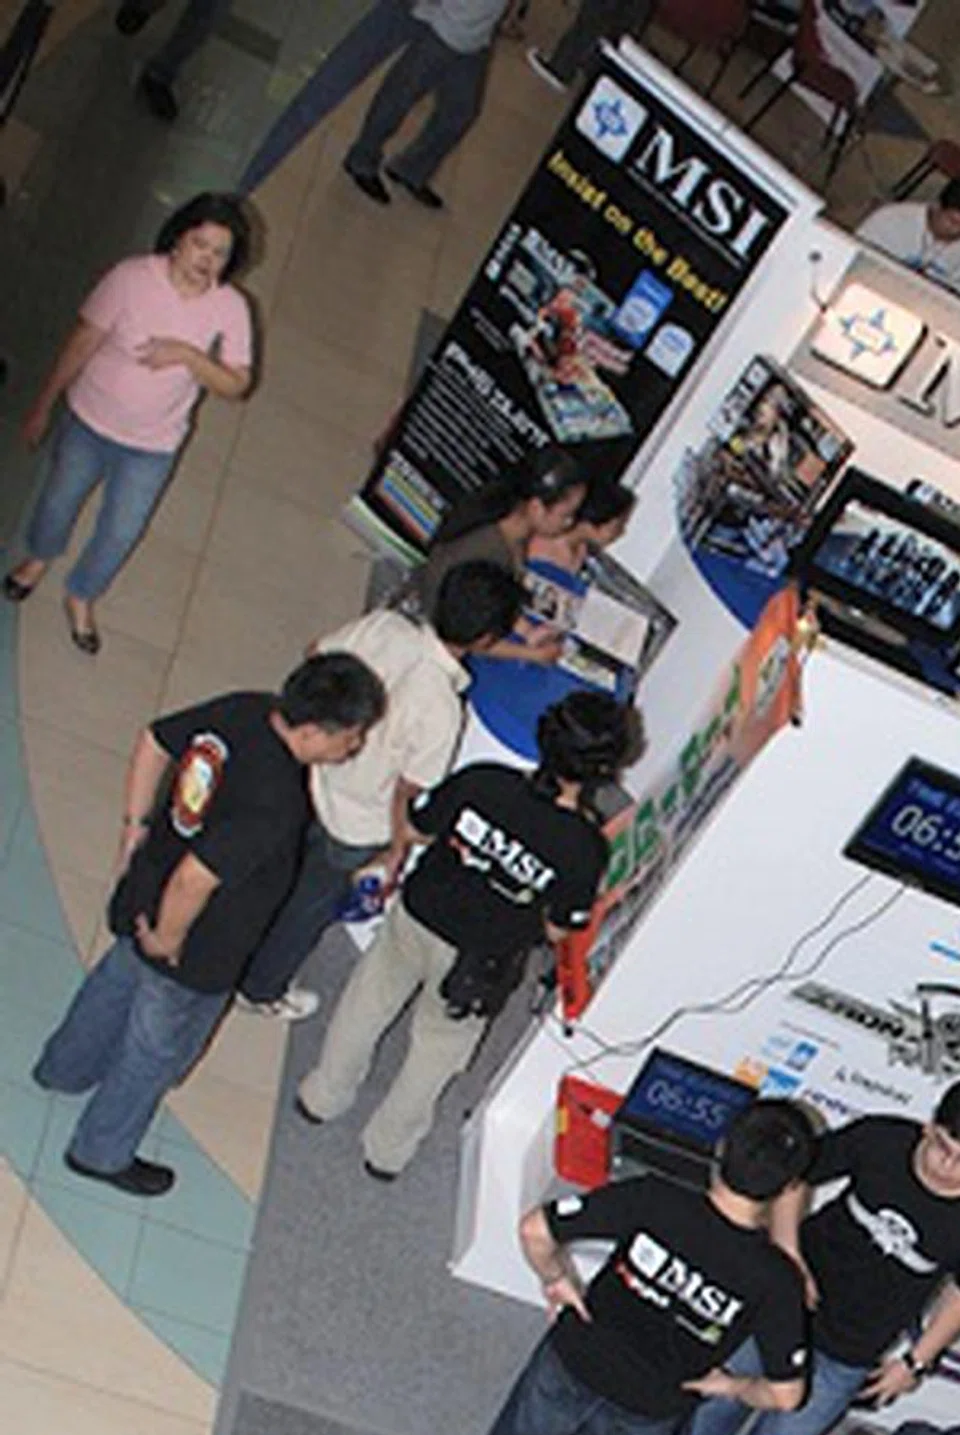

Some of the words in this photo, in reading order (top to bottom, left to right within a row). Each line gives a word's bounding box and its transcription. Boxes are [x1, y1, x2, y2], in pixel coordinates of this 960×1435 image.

[548, 150, 606, 211] Insist
[603, 205, 634, 234] on
[634, 227, 668, 265] the
[634, 125, 769, 256] MSI
[481, 829, 556, 891] MSI
[657, 1257, 742, 1325] MSI
